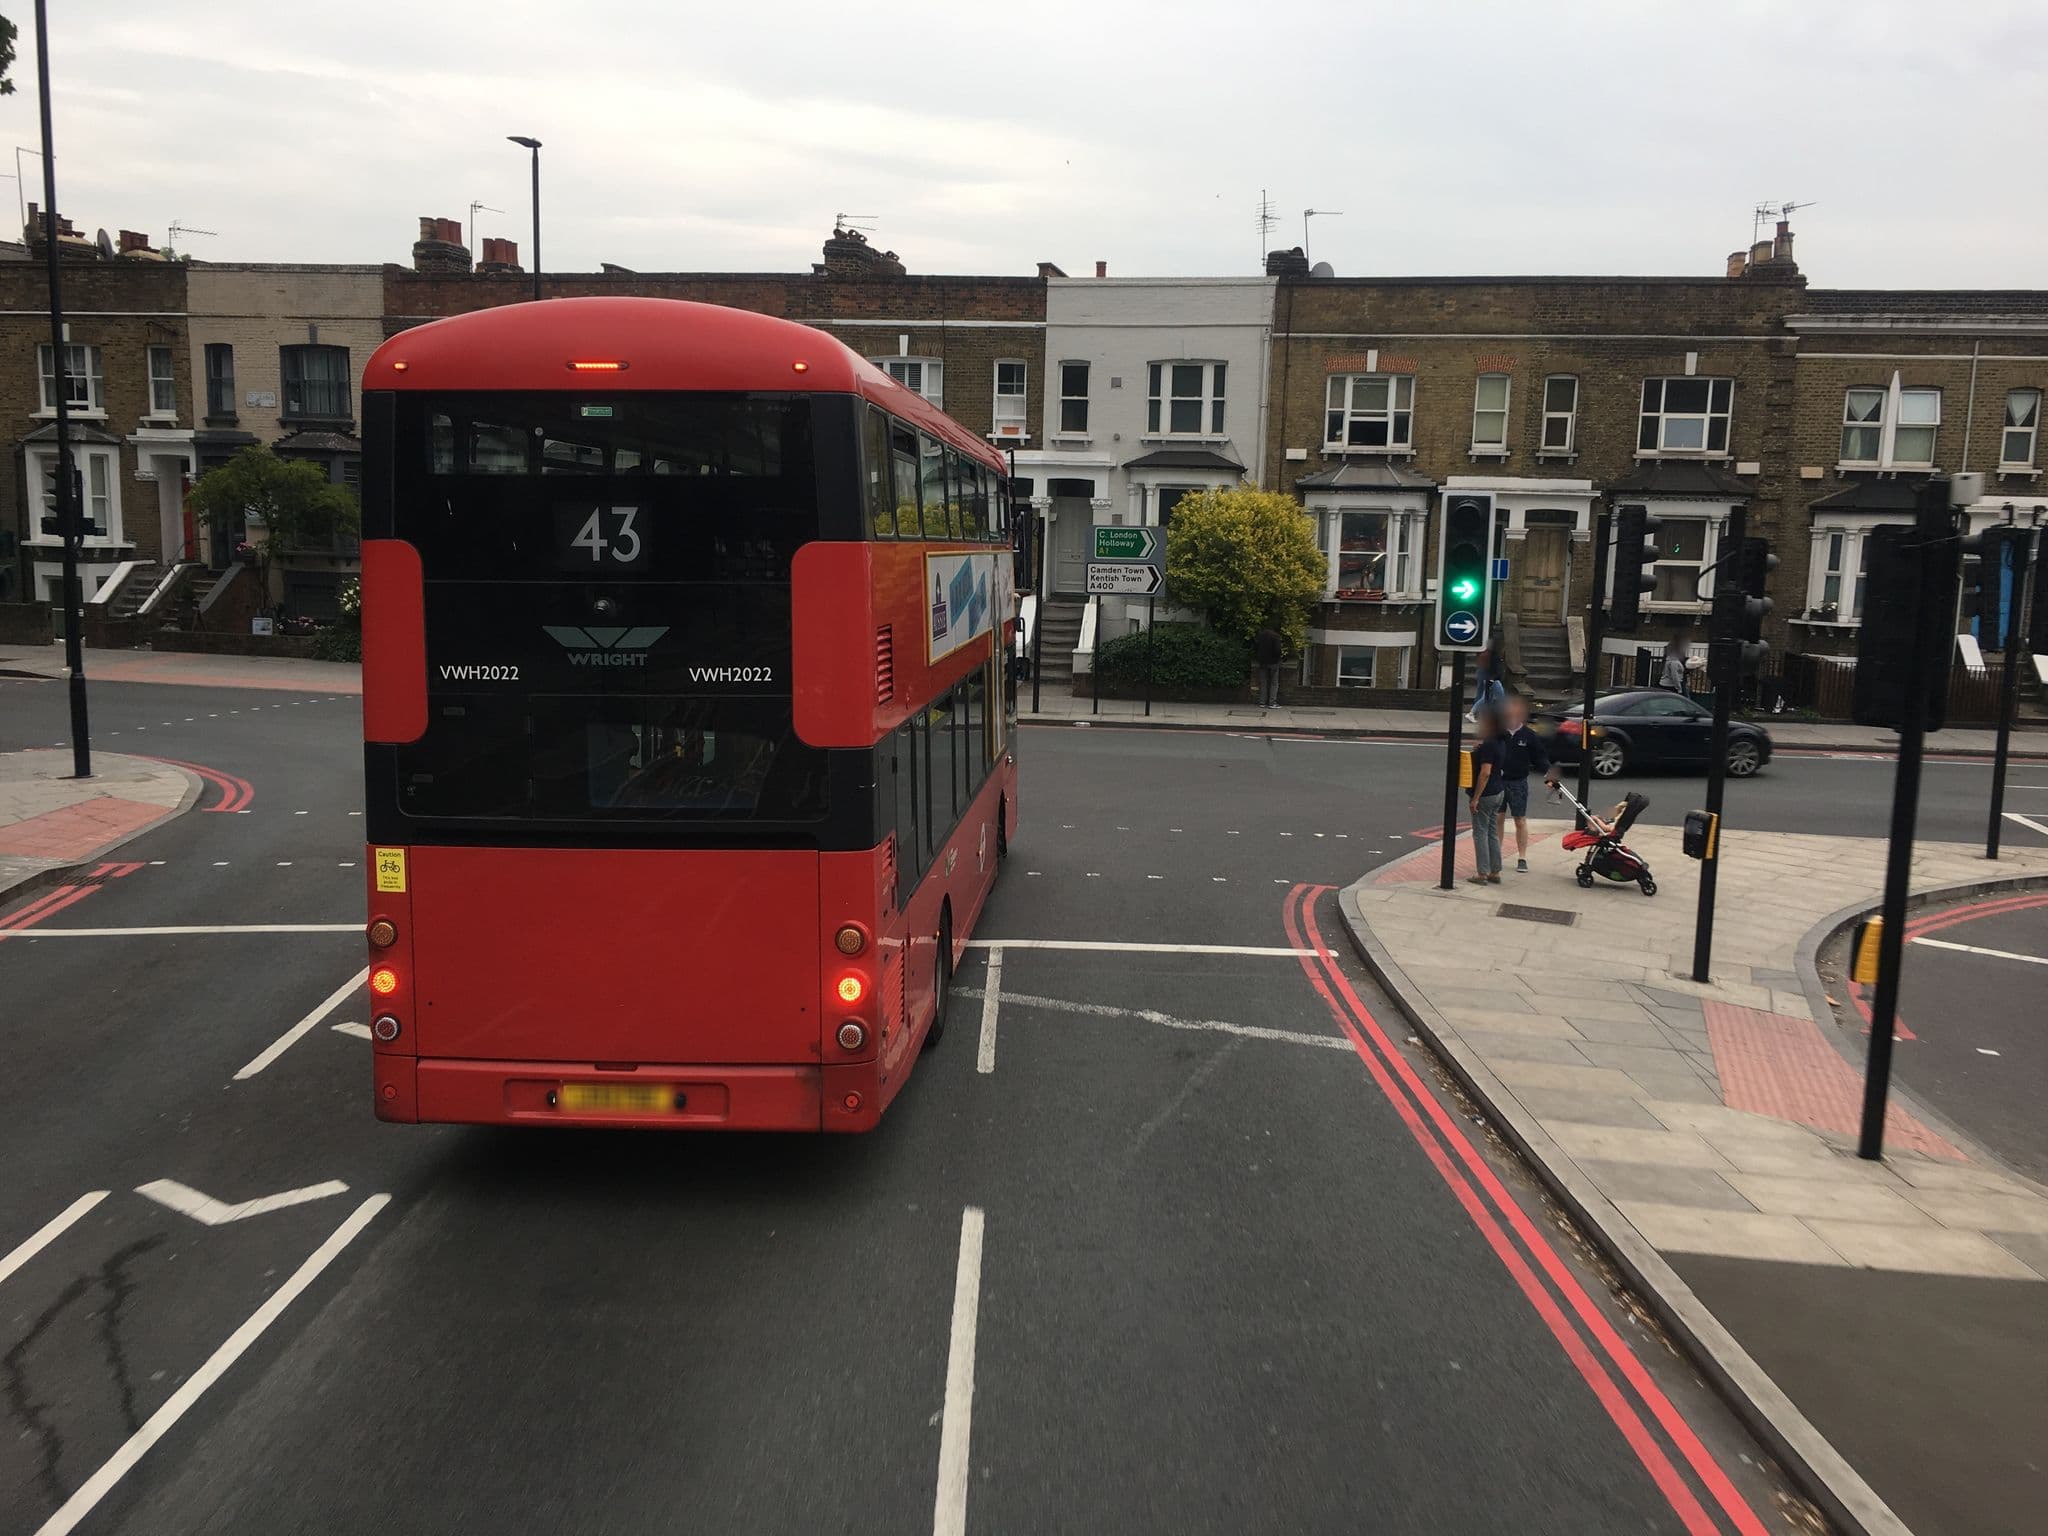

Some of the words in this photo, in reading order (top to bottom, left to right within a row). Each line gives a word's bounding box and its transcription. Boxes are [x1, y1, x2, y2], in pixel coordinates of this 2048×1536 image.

[570, 506, 641, 562] 43
[1110, 531, 1138, 539] London
[1099, 540, 1135, 548] Holloway
[1090, 566, 1122, 574] Camden
[568, 653, 648, 666] WRIGHT
[440, 665, 520, 681] VWH2022
[689, 667, 772, 682] VWH2022
